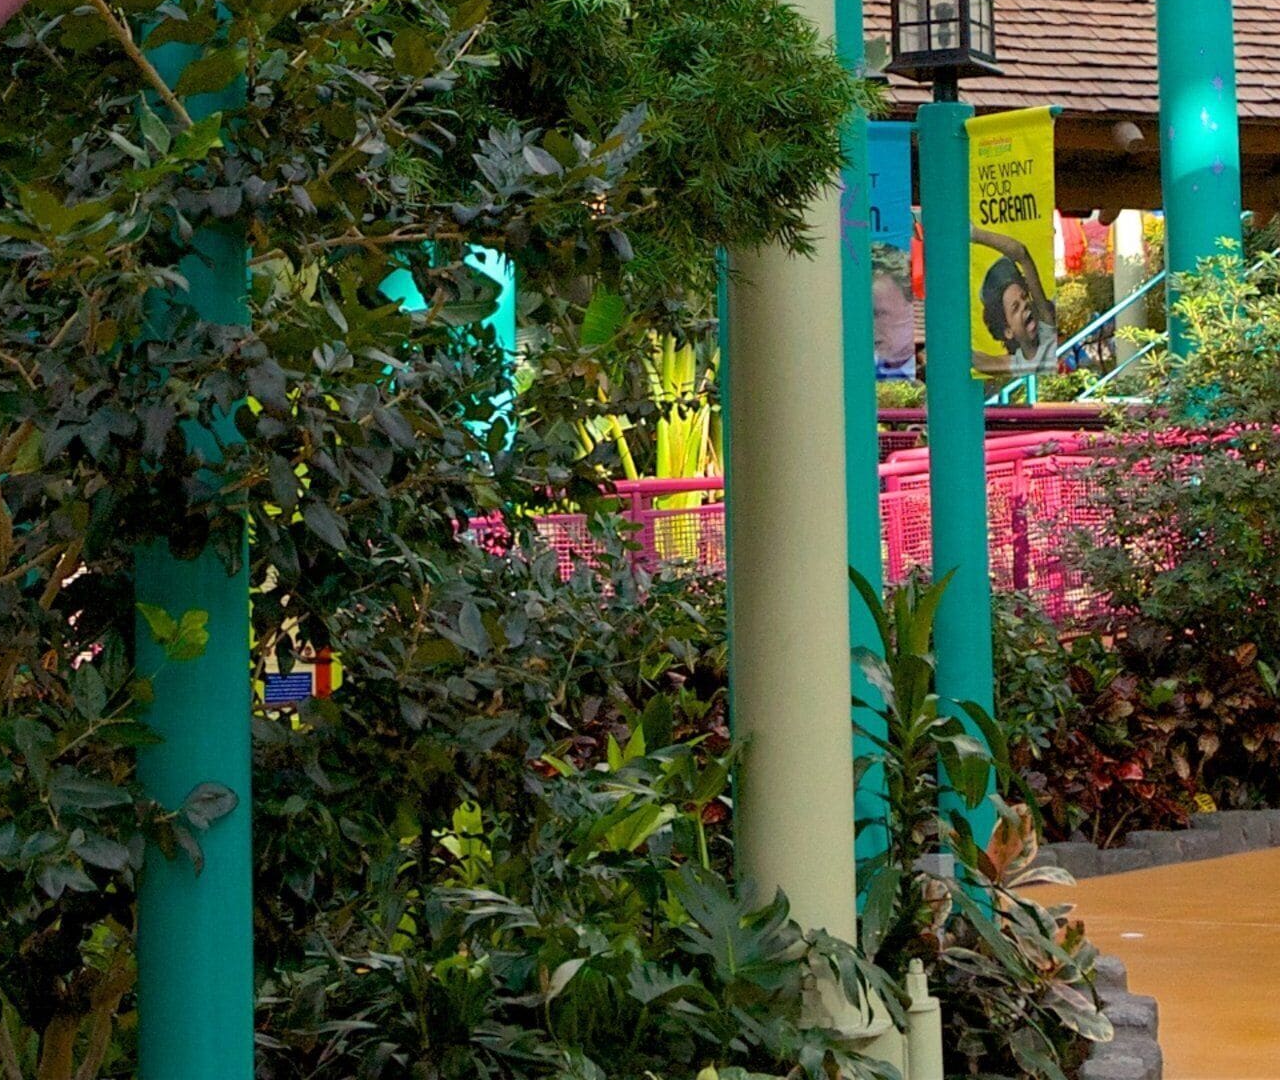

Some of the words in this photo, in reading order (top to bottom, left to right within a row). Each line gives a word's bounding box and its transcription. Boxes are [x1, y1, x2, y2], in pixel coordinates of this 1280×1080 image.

[978, 164, 997, 181] WE
[998, 159, 1034, 179] WANT
[978, 179, 1012, 198] YOUR
[979, 193, 1042, 225] SCREAM.
